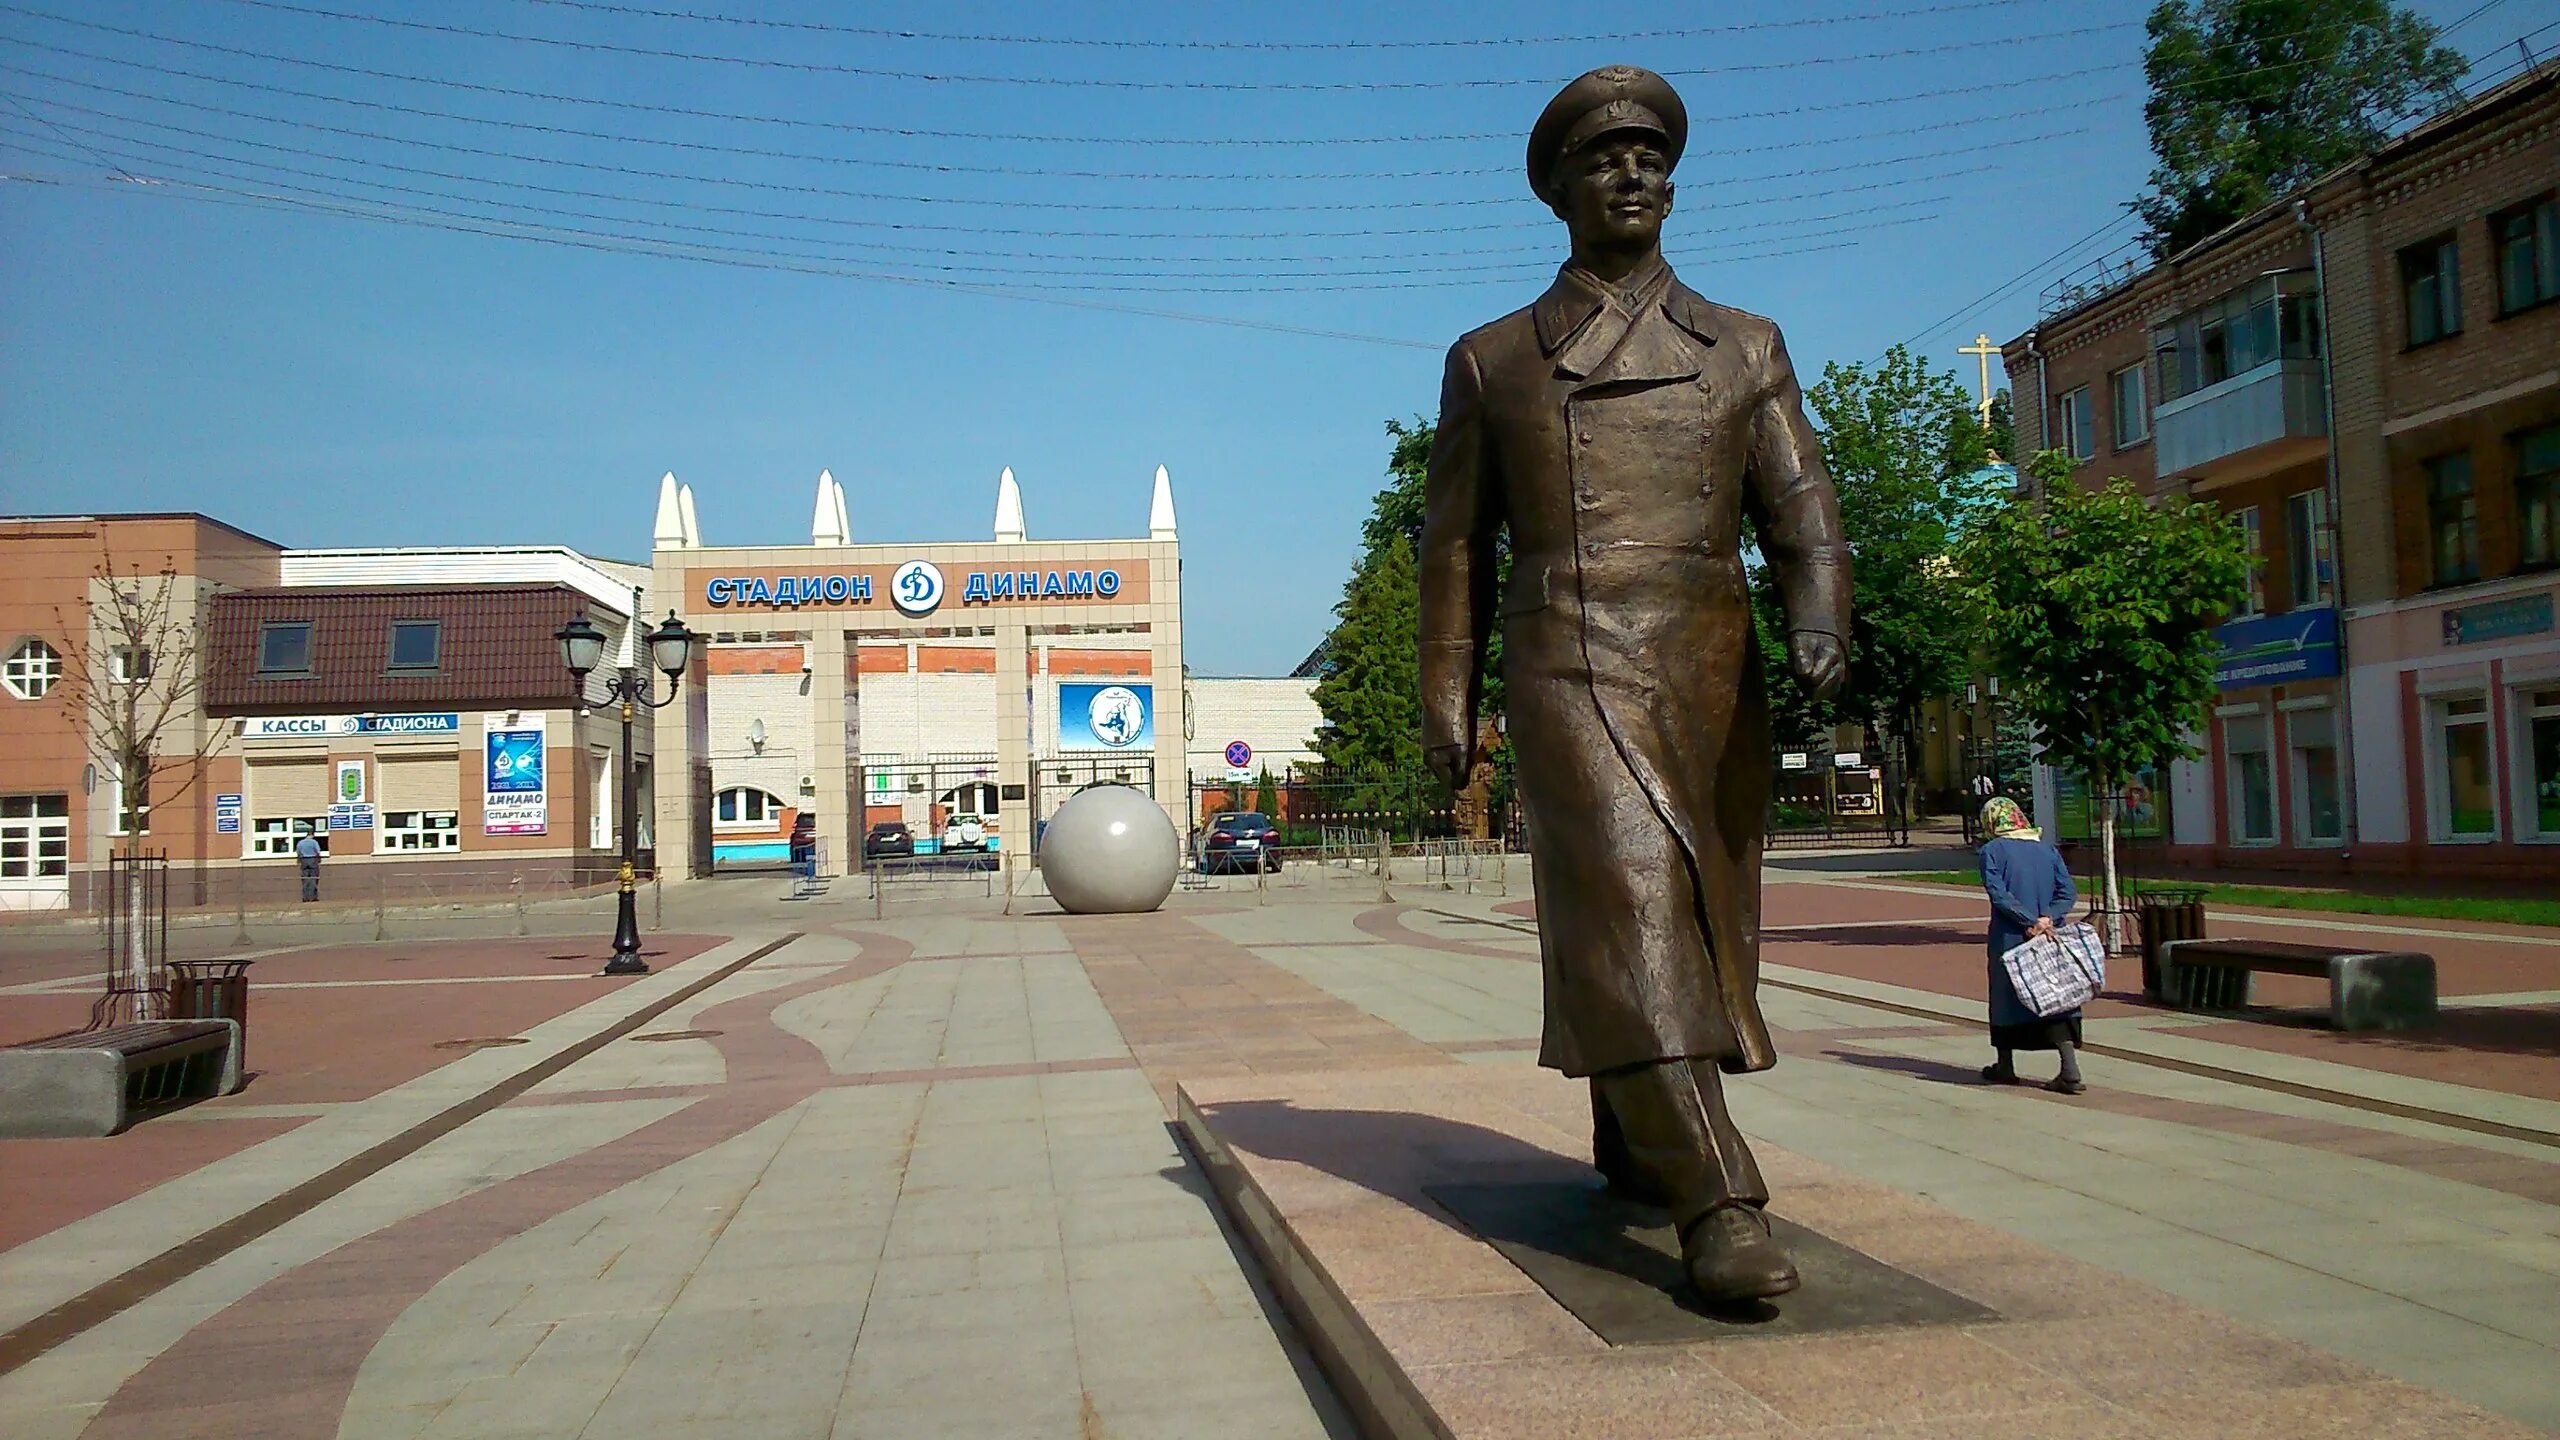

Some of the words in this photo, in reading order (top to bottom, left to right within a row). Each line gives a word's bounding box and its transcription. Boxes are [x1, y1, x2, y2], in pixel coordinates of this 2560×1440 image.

[707, 575, 874, 604] СТАДИОН
[964, 569, 1122, 600] ДИНАМО
[262, 719, 326, 733] КАССЫ
[366, 716, 449, 733] СТАДИОНА
[487, 793, 543, 806] ДИНАМО
